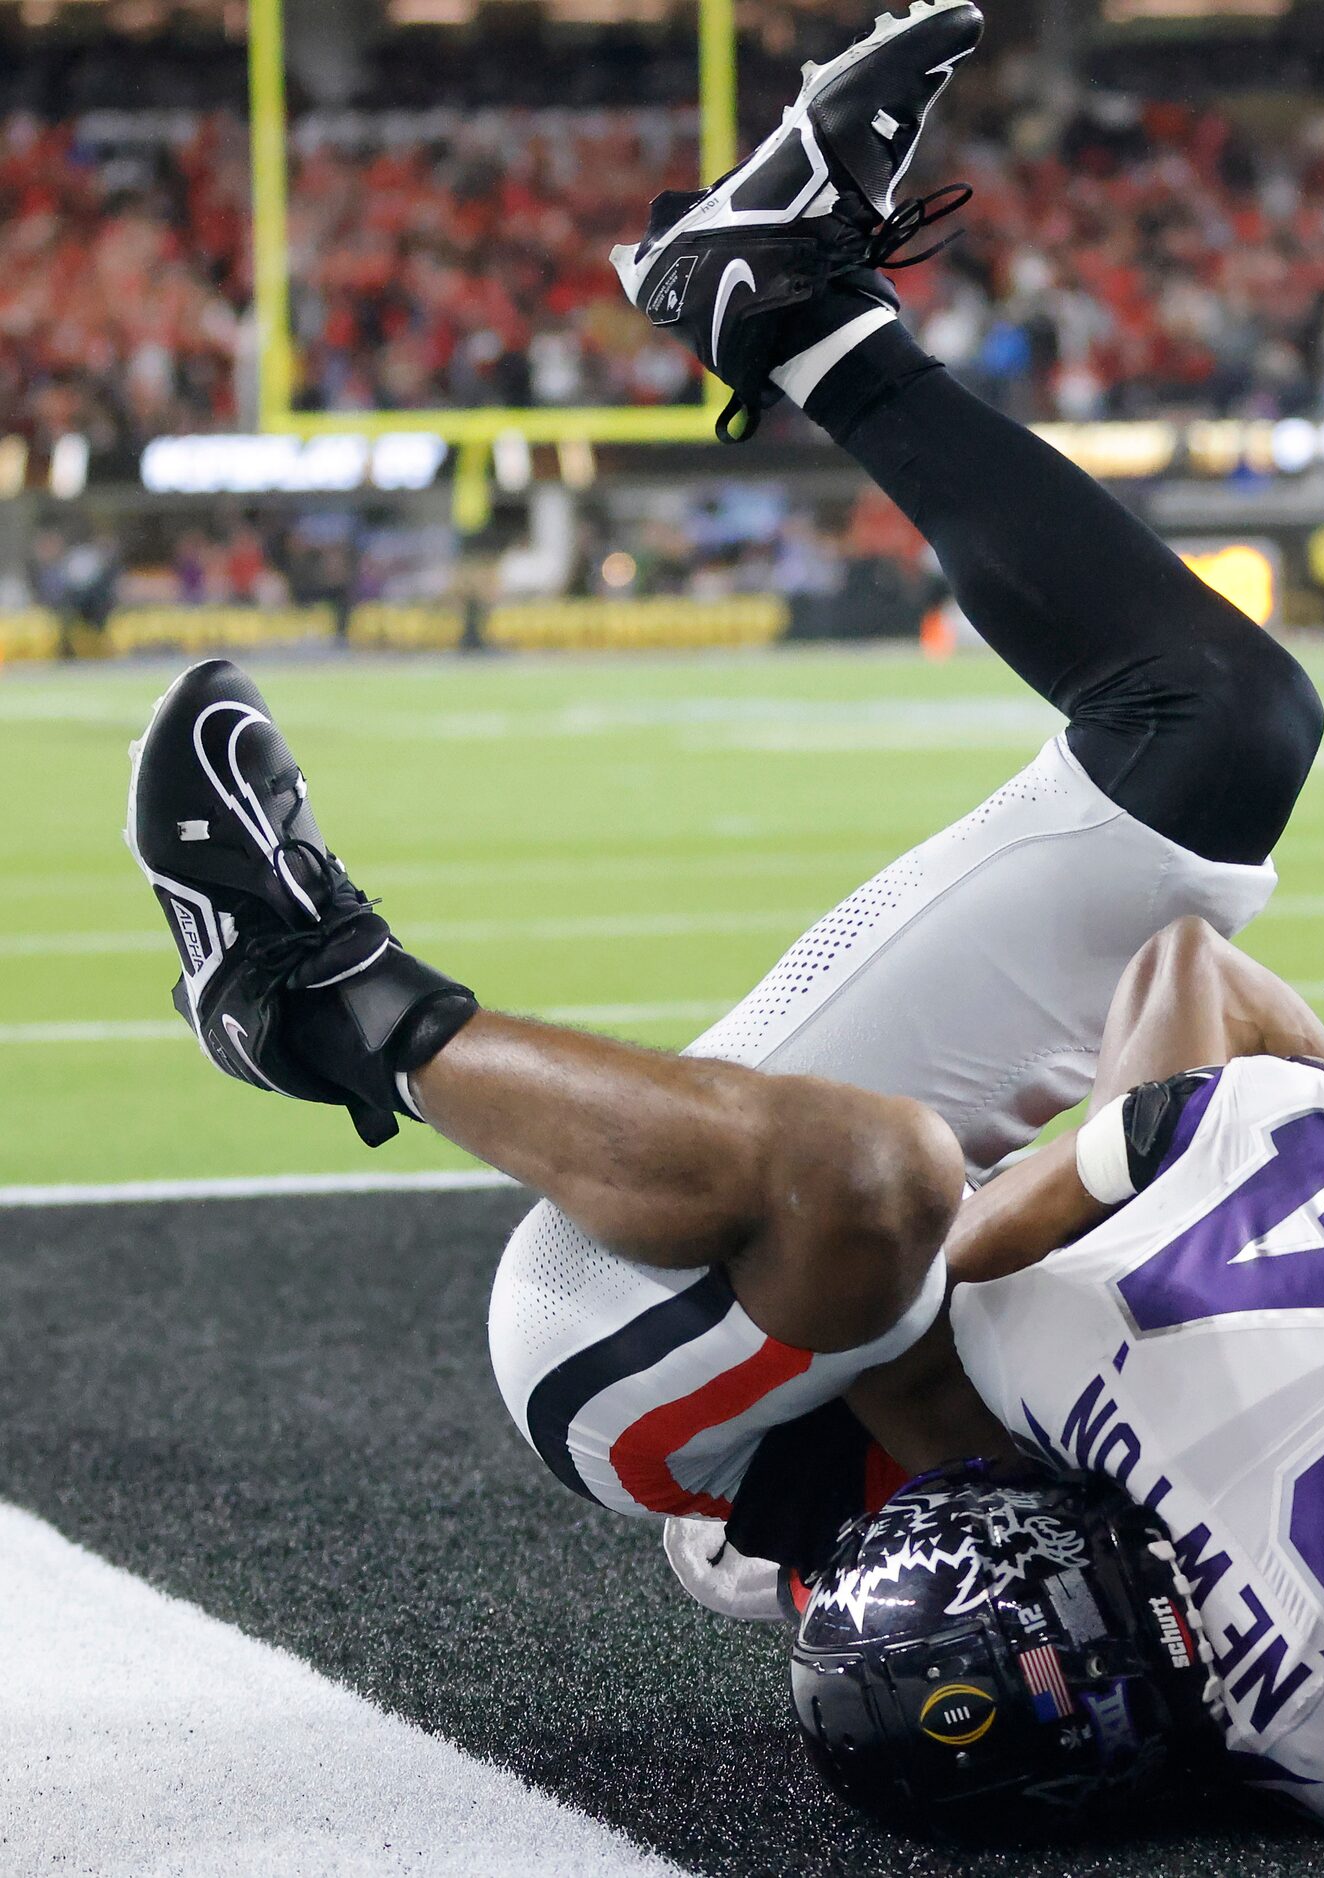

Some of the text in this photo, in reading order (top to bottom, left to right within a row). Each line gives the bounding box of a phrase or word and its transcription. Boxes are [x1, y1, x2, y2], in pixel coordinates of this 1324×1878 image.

[176, 905, 204, 973] ALPHA
[1018, 1603, 1047, 1634] 12
[1148, 1596, 1191, 1669] schutt
